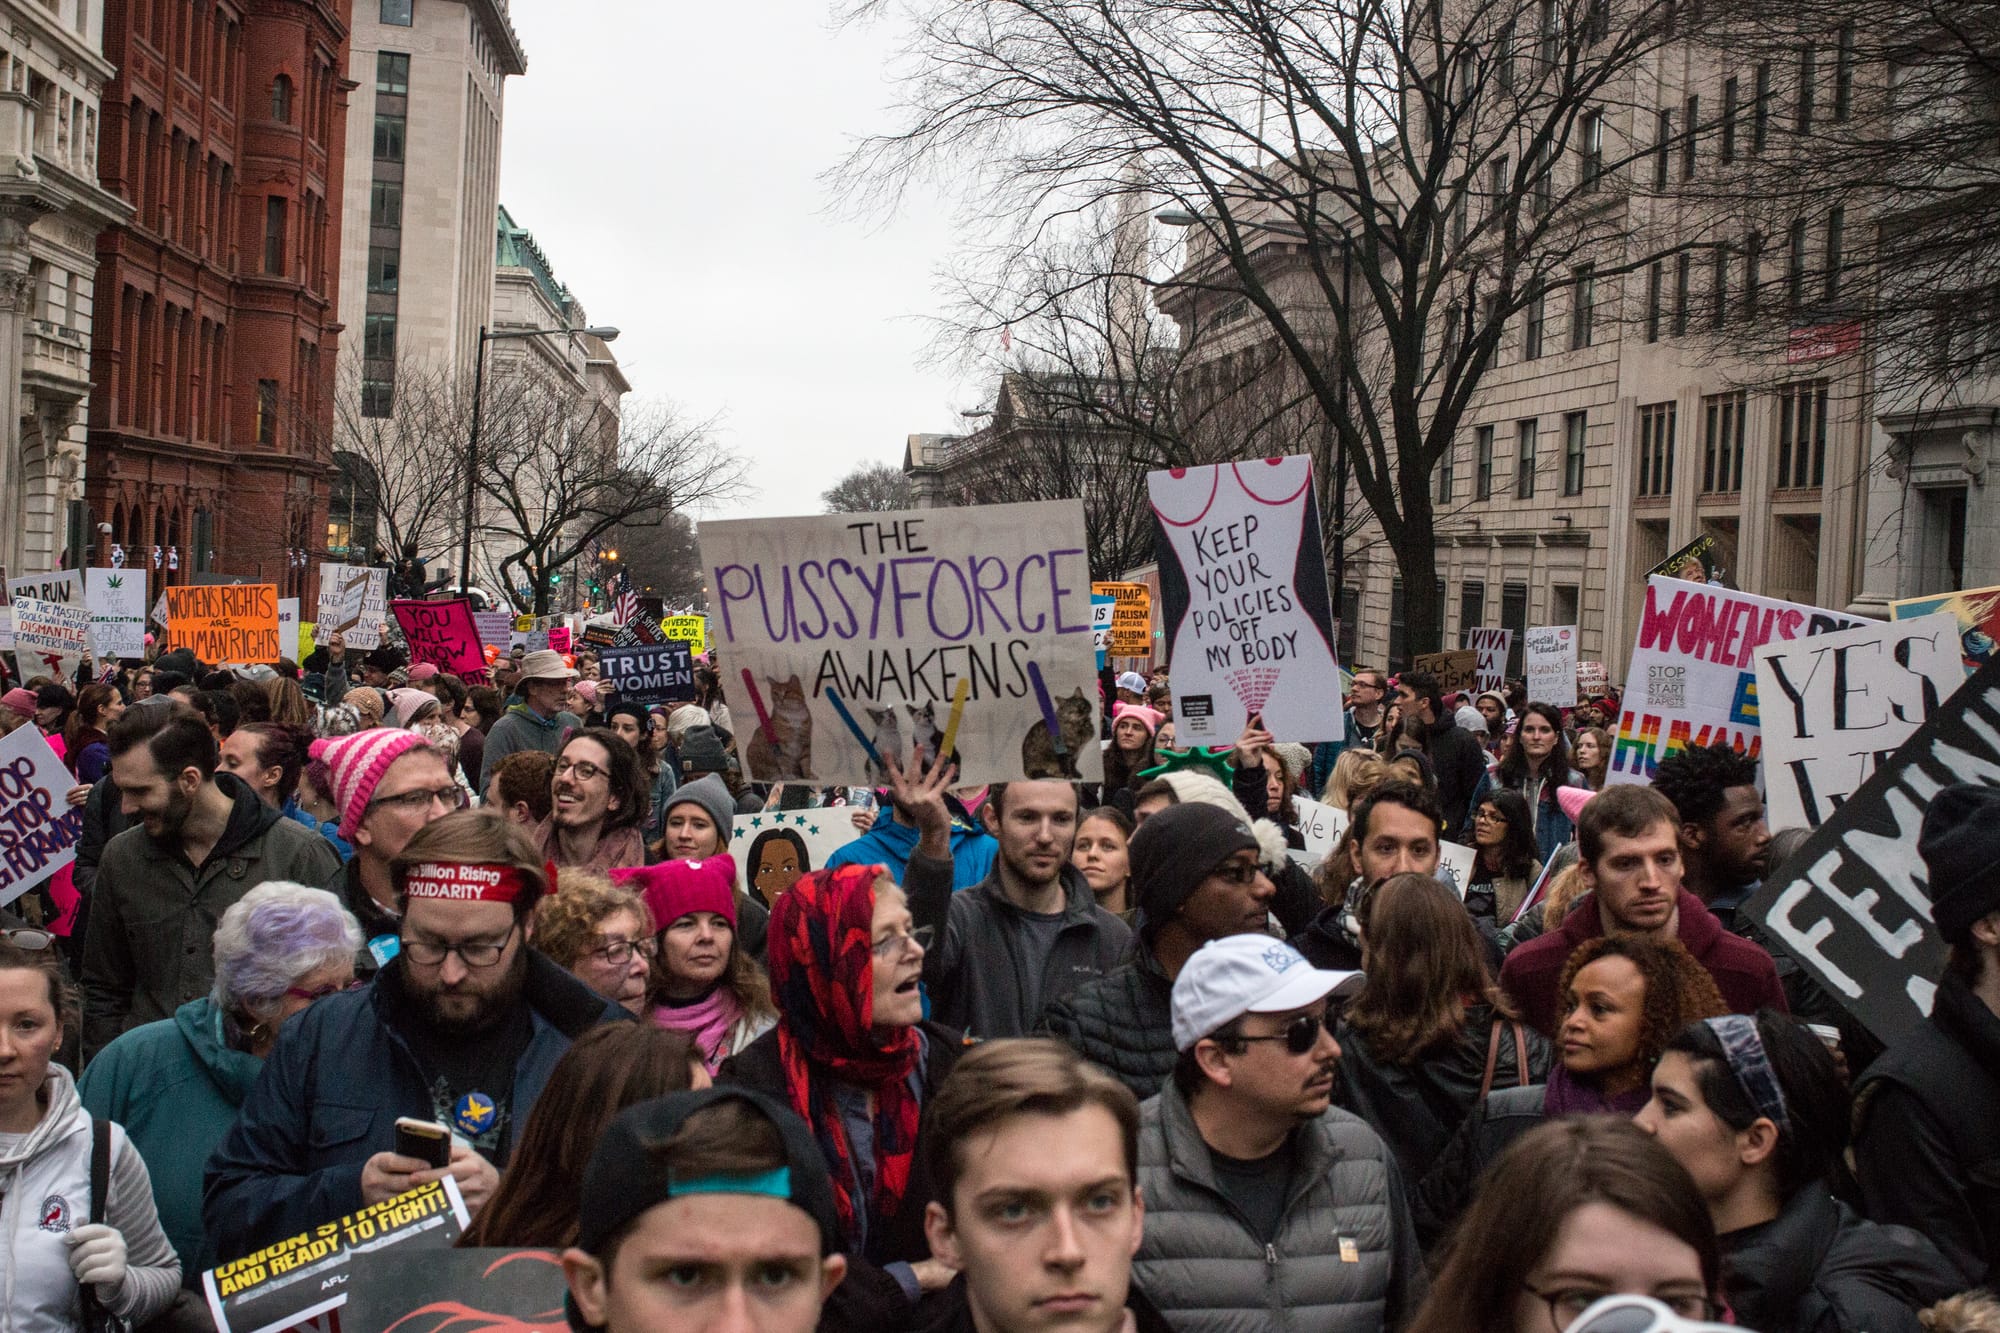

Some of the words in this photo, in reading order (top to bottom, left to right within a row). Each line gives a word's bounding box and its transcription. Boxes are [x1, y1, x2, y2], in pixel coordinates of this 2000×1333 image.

[846, 518, 928, 555] THE
[1191, 514, 1259, 567] KEEP
[1195, 551, 1272, 602] YOUR
[41, 579, 71, 603] RUN
[714, 547, 1091, 644] PUSSYFORCE
[1101, 587, 1142, 600] TRUMP
[36, 601, 52, 613] THE
[166, 586, 220, 620] WOMEN'S
[221, 585, 273, 619] RIGHTS
[1192, 584, 1293, 640] POLICIES
[17, 610, 41, 624] TOOLS
[44, 615, 61, 626] WILL
[61, 619, 90, 632] NEVER
[209, 618, 232, 628] ARE
[404, 607, 451, 629] YOU
[663, 618, 700, 628] DIVERSITY
[1094, 607, 1106, 621] IS
[20, 620, 87, 643] DISMANTLE
[346, 631, 380, 646] STUFF
[404, 626, 455, 645] WILL
[669, 628, 679, 638] IS
[682, 627, 699, 638] OUR
[1229, 616, 1262, 642] OFF
[22, 632, 61, 649] MASTERS
[229, 627, 279, 660] RIGHTS
[412, 640, 467, 661] KNOW
[1205, 643, 1233, 672] MY
[1242, 630, 1299, 666] BODY
[1471, 629, 1506, 652] VIVA
[1526, 634, 1554, 651] Special
[1535, 639, 1569, 655] Educator
[601, 650, 690, 677] TRUST
[812, 639, 1030, 702] AWAKENS
[1414, 655, 1455, 675] FUCK
[1476, 652, 1495, 670] LA
[1528, 661, 1569, 676] AGAINST
[1648, 665, 1686, 678] STOP
[610, 670, 693, 693] WOMEN
[1469, 674, 1504, 695] ULVA
[1648, 683, 1686, 694] START
[1763, 632, 1938, 739] YES
[1297, 804, 1324, 840] We
[459, 865, 501, 887] Rising
[409, 881, 486, 899] SOLIDARITY
[220, 1264, 268, 1298] AND
[270, 1232, 341, 1276] READY
[343, 1220, 377, 1245] TO
[377, 1188, 448, 1233] FIGHT!
[215, 1232, 309, 1280] UNION
